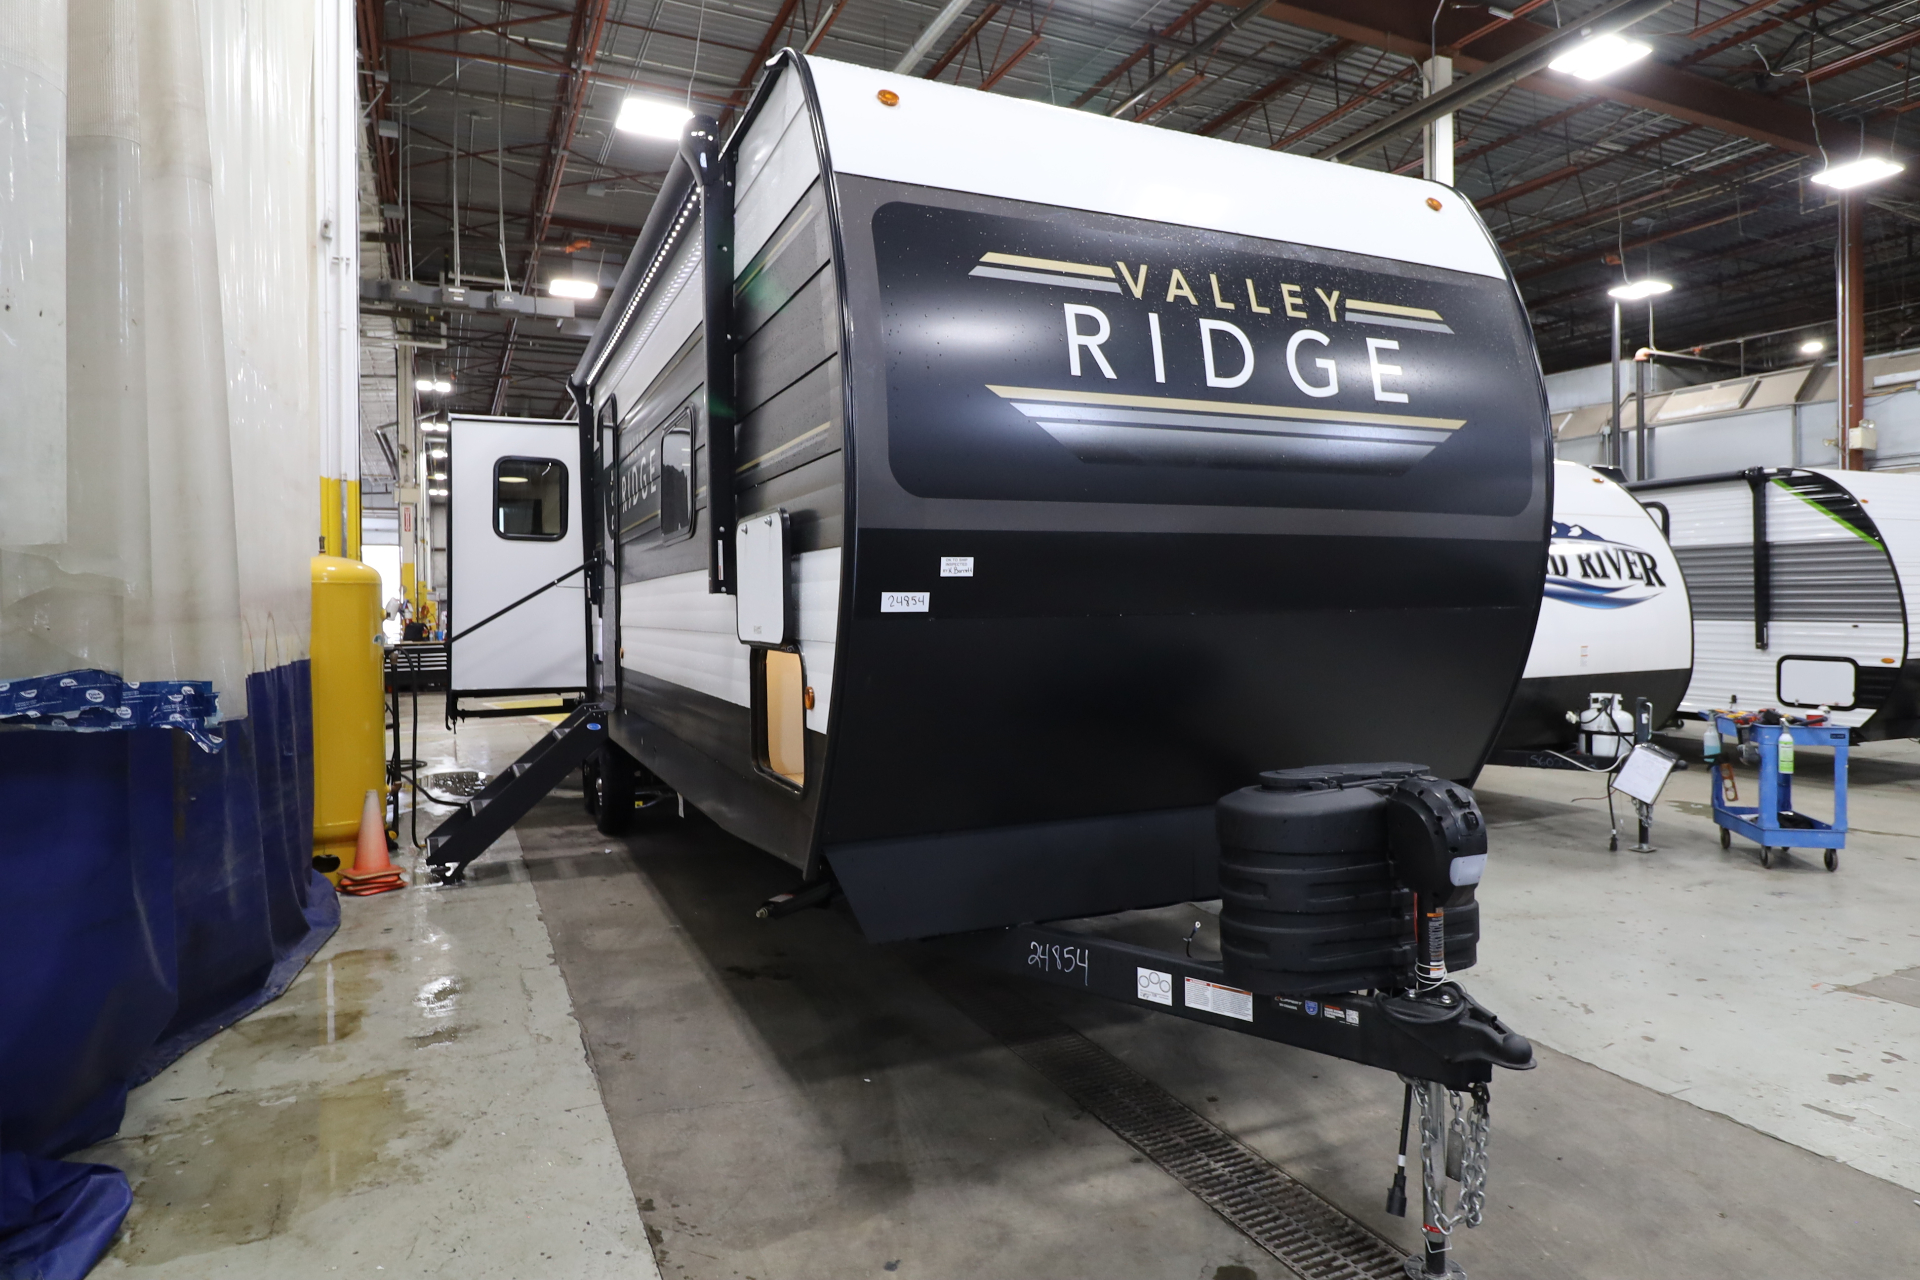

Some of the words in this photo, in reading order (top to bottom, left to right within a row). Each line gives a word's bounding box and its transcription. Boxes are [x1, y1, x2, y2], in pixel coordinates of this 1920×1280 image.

[1115, 260, 1341, 323] VALLEY
[1063, 302, 1409, 404] RIDGE
[621, 447, 657, 513] RIDGE
[1572, 544, 1667, 588] RIVER
[887, 594, 926, 608] 24854
[1027, 940, 1089, 986] 24854
